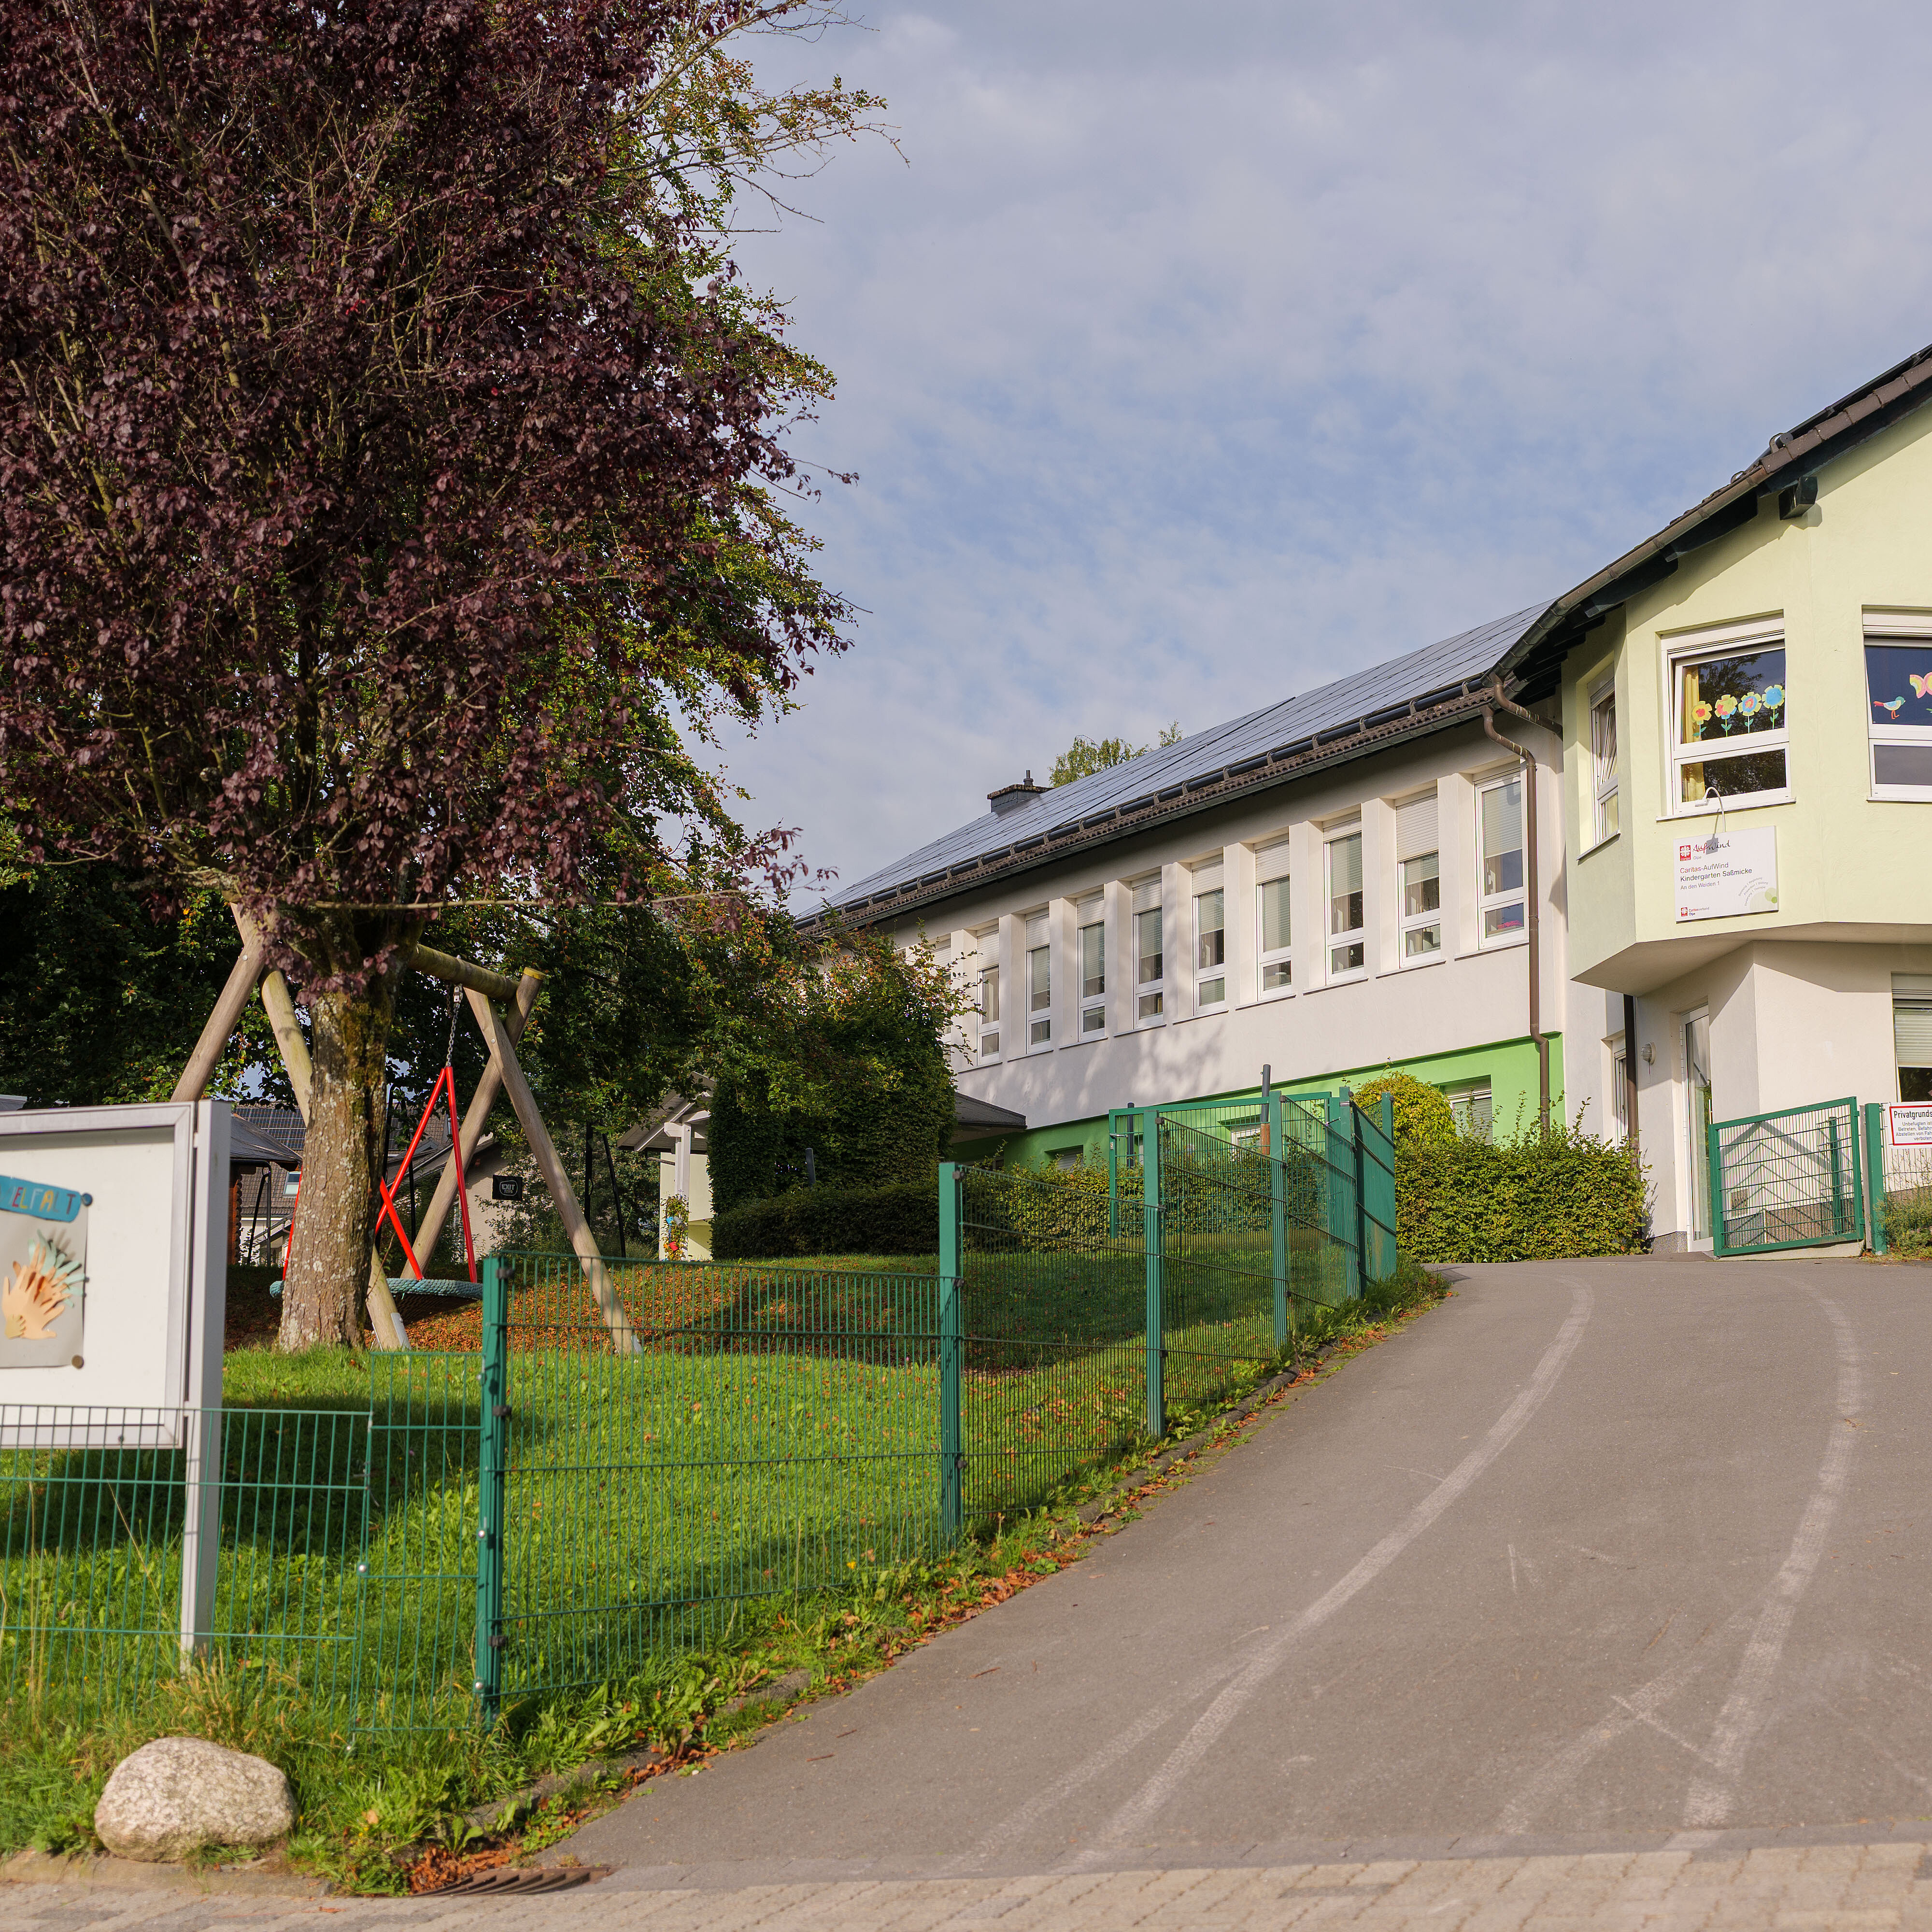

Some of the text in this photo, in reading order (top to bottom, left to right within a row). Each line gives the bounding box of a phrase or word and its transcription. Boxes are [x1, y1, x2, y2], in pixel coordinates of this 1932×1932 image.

[1680, 862, 1729, 874] Caritas-AufWind
[1680, 868, 1752, 881] Kindergarten Saßmicke
